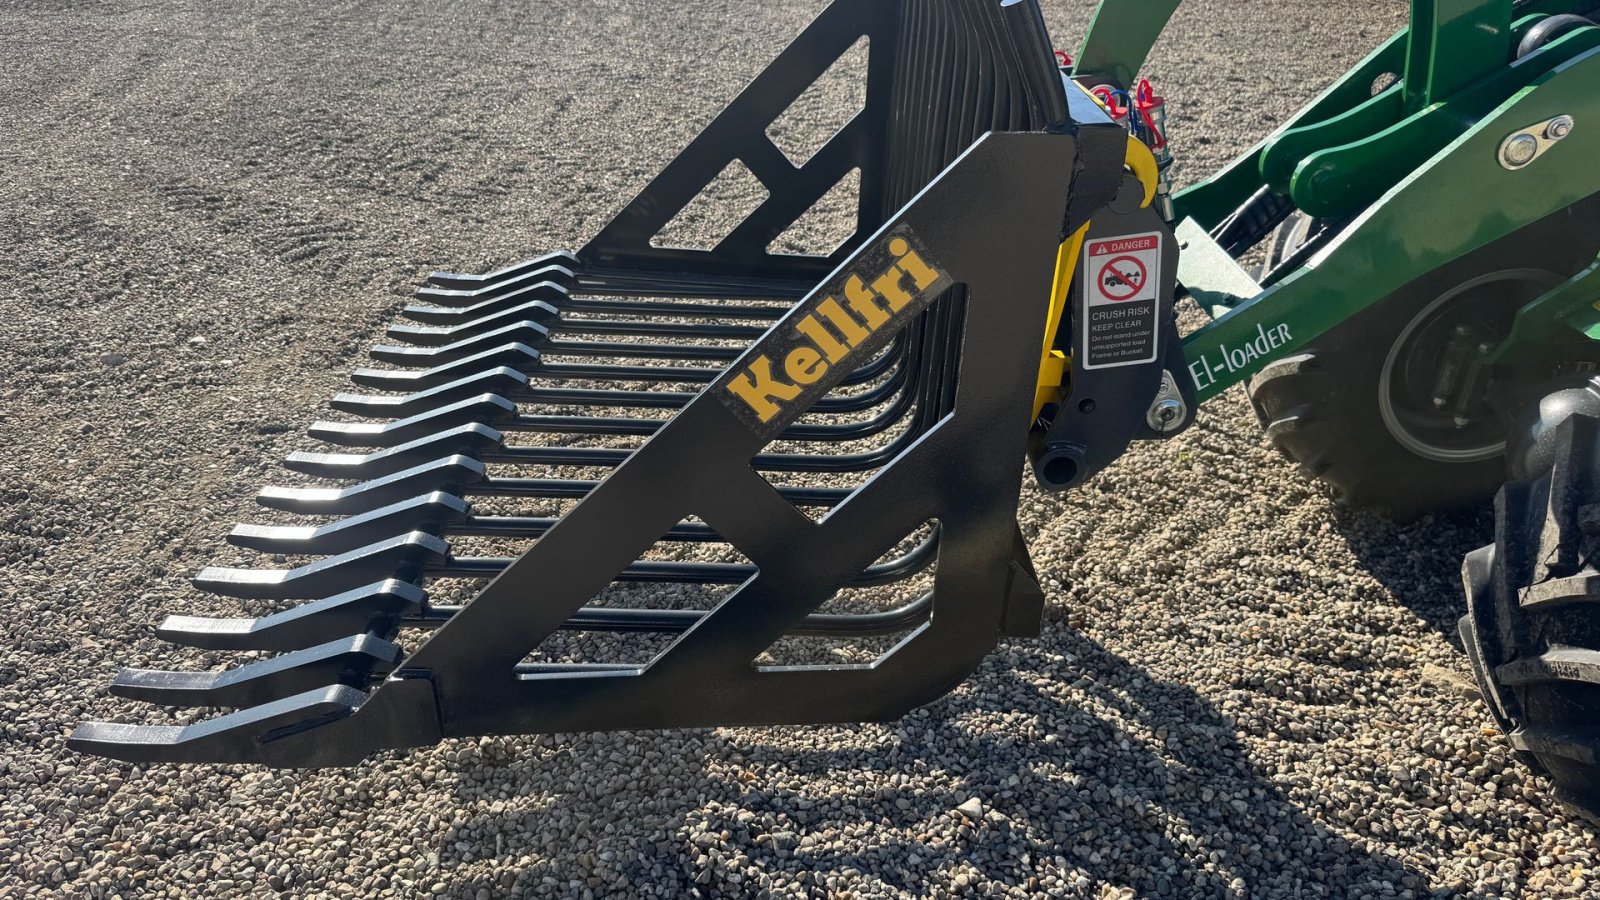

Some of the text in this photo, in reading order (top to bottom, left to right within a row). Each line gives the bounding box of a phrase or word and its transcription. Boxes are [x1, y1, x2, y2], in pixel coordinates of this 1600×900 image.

[1111, 239, 1150, 252] DANGER
[1092, 306, 1150, 320] CRUSH RISK
[726, 239, 940, 423] Kellfri
[1092, 320, 1141, 332] KEEP CLEAR
[1092, 341, 1130, 350] unsupported
